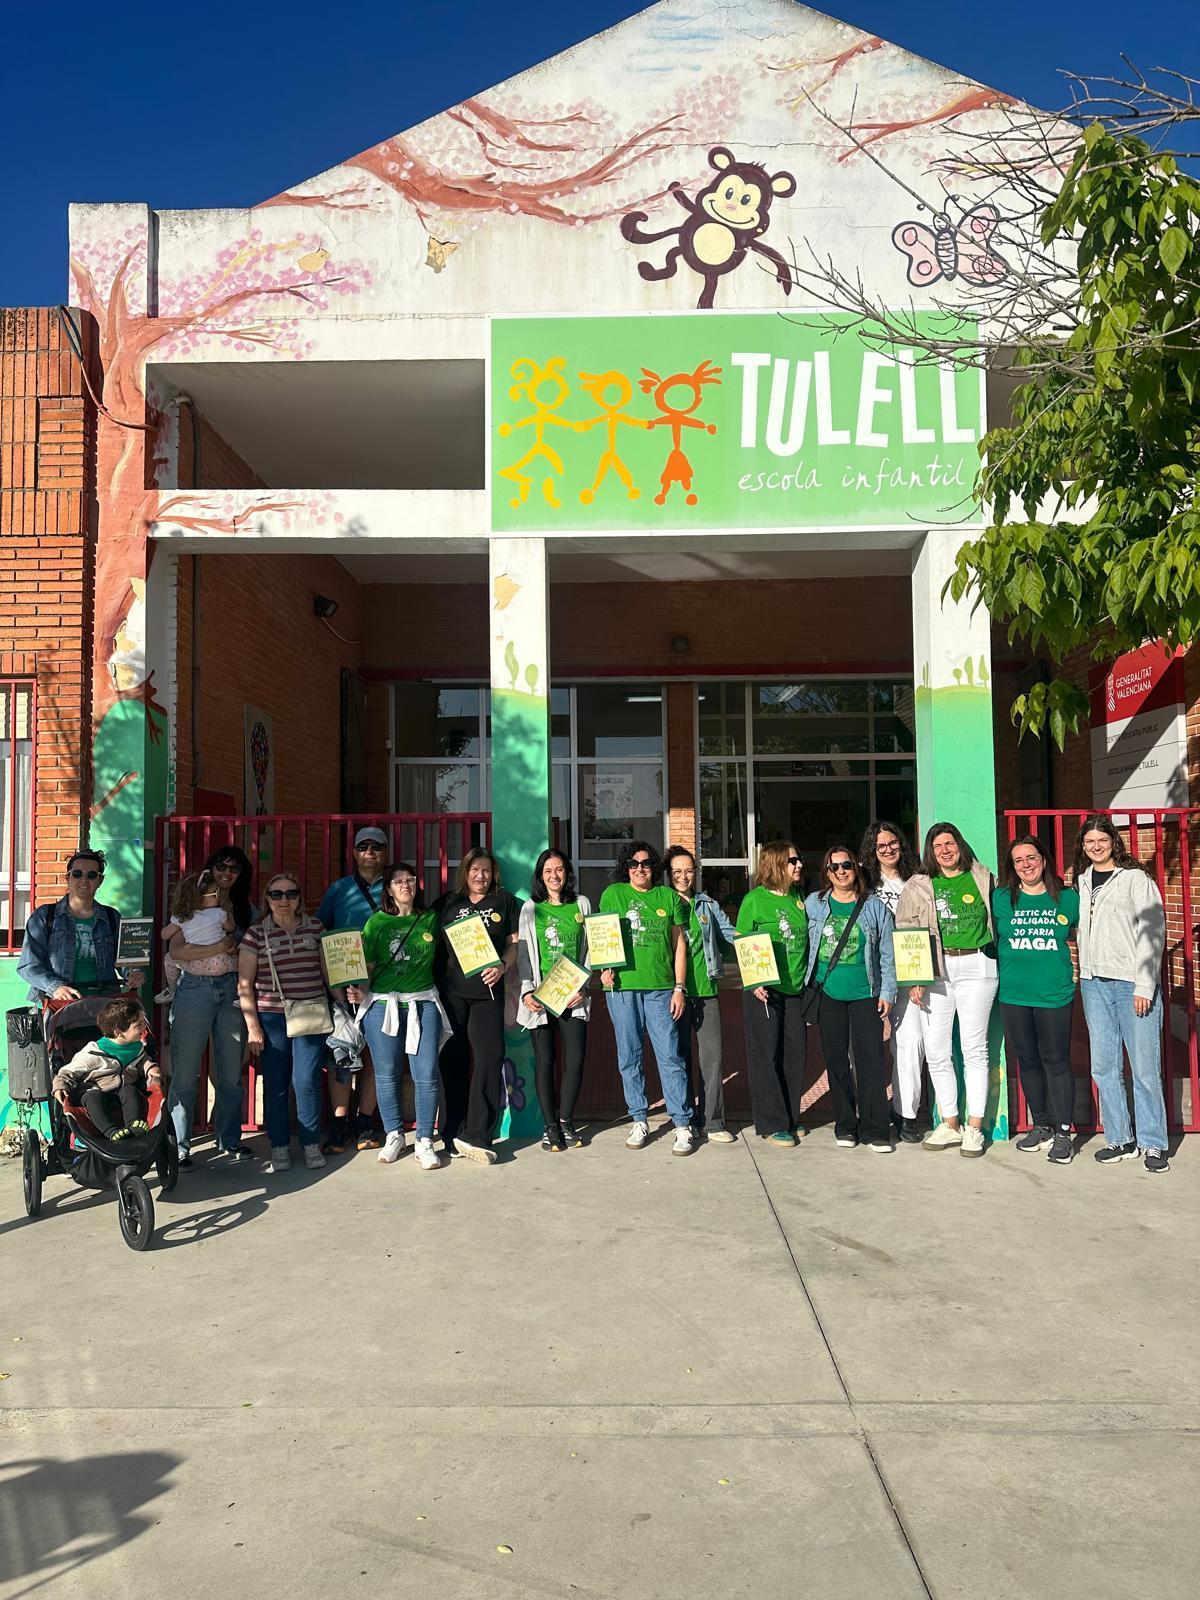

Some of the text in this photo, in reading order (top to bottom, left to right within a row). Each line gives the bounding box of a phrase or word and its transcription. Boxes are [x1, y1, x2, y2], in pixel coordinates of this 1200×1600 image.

[731, 349, 976, 456] TULELL
[738, 454, 966, 495] escola infantil
[1115, 667, 1152, 688] GENERALITAT
[1116, 681, 1152, 700] VALENCIANA
[1142, 759, 1159, 770] TULELL
[1041, 908, 1057, 916] ACÍ
[1010, 917, 1059, 926] OBLIGADA,
[1013, 928, 1054, 936] JO FARIA
[1008, 938, 1059, 951] VAGA
